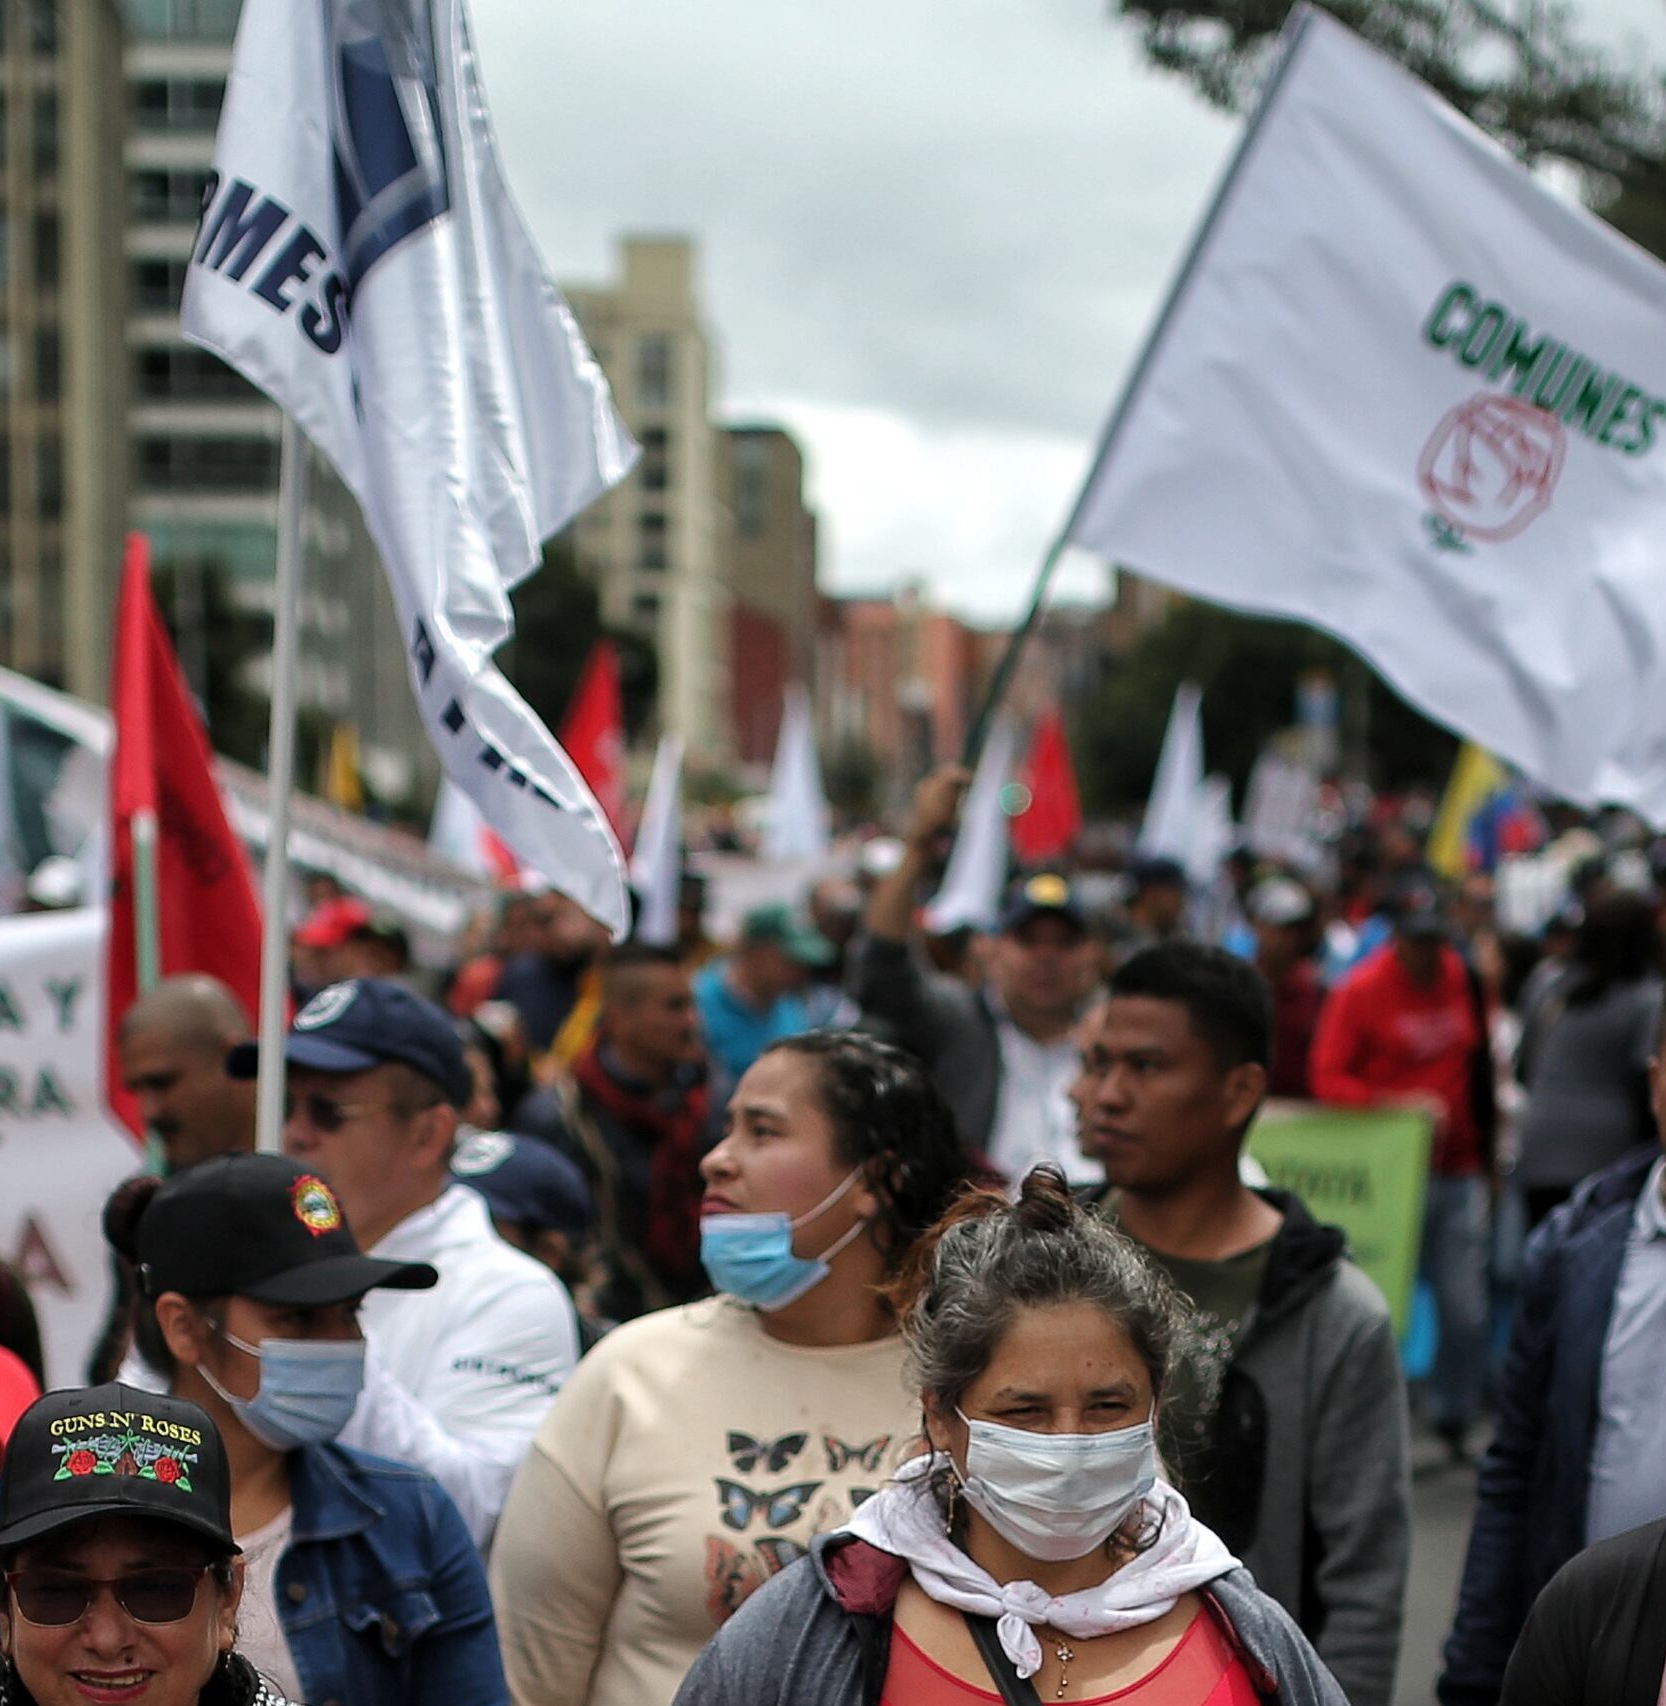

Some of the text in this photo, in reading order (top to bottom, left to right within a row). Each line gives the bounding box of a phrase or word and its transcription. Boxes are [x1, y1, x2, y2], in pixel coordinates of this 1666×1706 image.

[50, 1412, 201, 1445] GUNS N' ROSES
